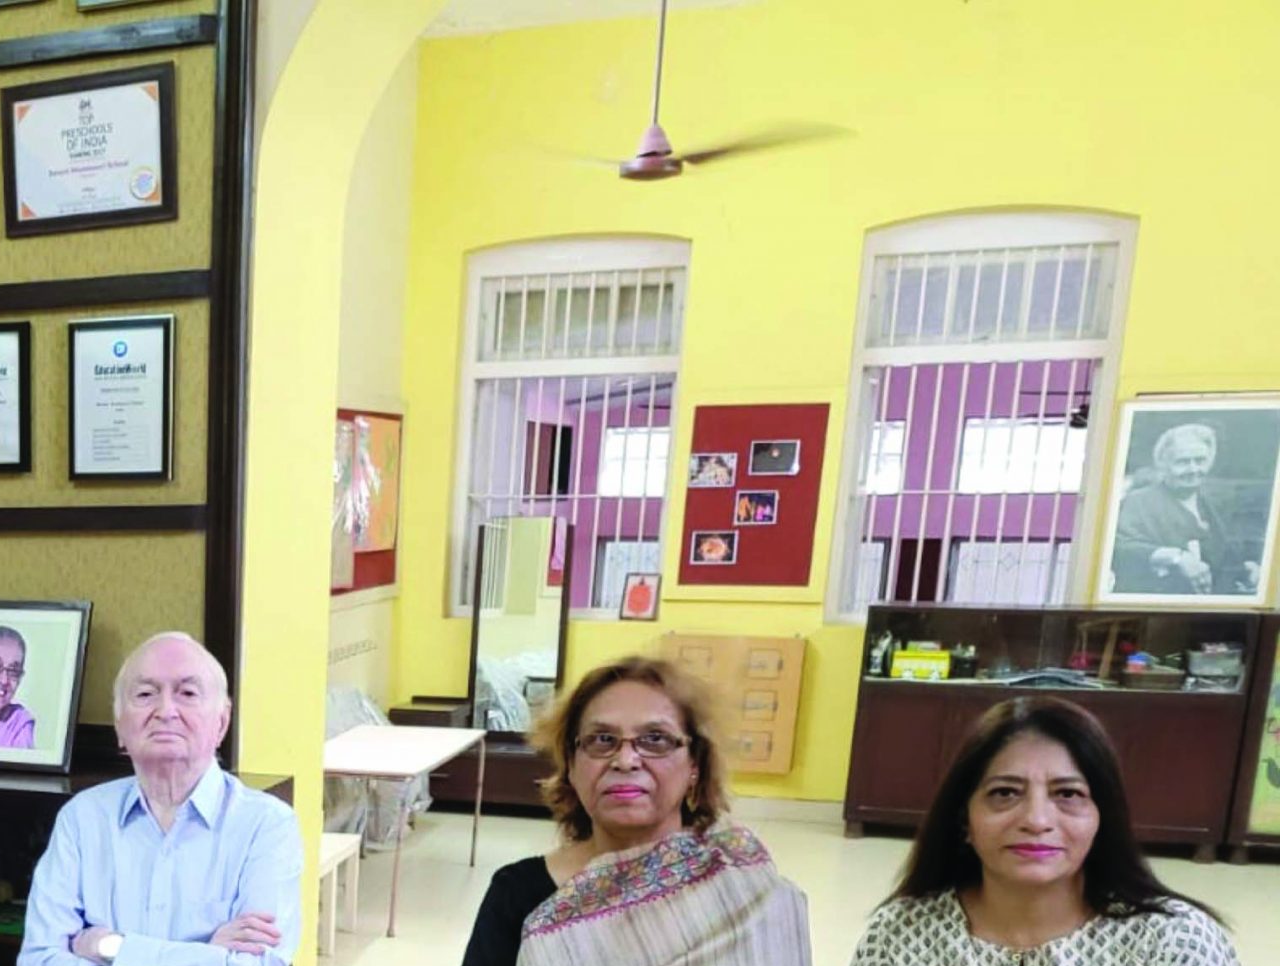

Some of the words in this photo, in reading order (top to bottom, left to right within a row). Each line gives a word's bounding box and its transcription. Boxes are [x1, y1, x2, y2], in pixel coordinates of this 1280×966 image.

[61, 123, 114, 139] PRESCHOOLS
[66, 138, 79, 151] OF
[81, 136, 107, 149] INDIA
